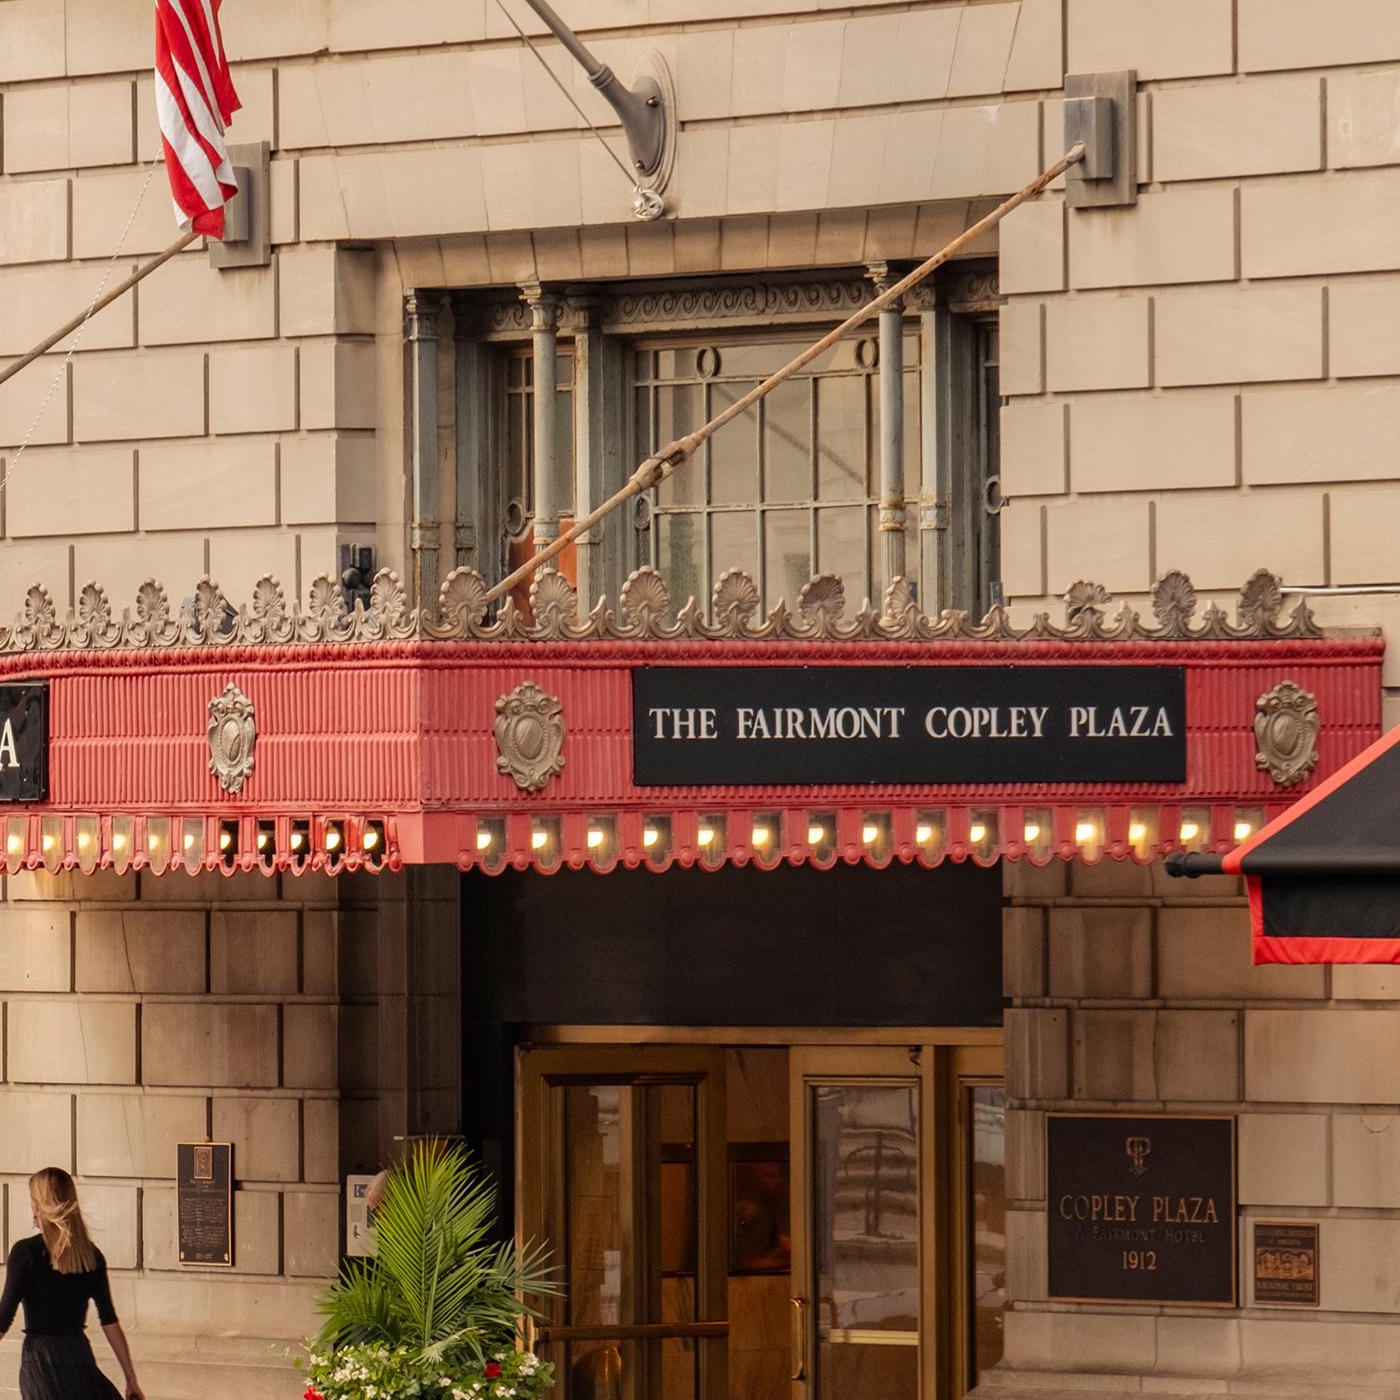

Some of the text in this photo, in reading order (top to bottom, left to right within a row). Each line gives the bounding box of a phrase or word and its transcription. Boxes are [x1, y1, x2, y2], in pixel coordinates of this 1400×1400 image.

[648, 706, 1174, 739] THE FAIRMONT COPLEY PLAZA
[1060, 1194, 1219, 1223] COPLEY PLAZA
[1122, 1250, 1157, 1270] 1912
